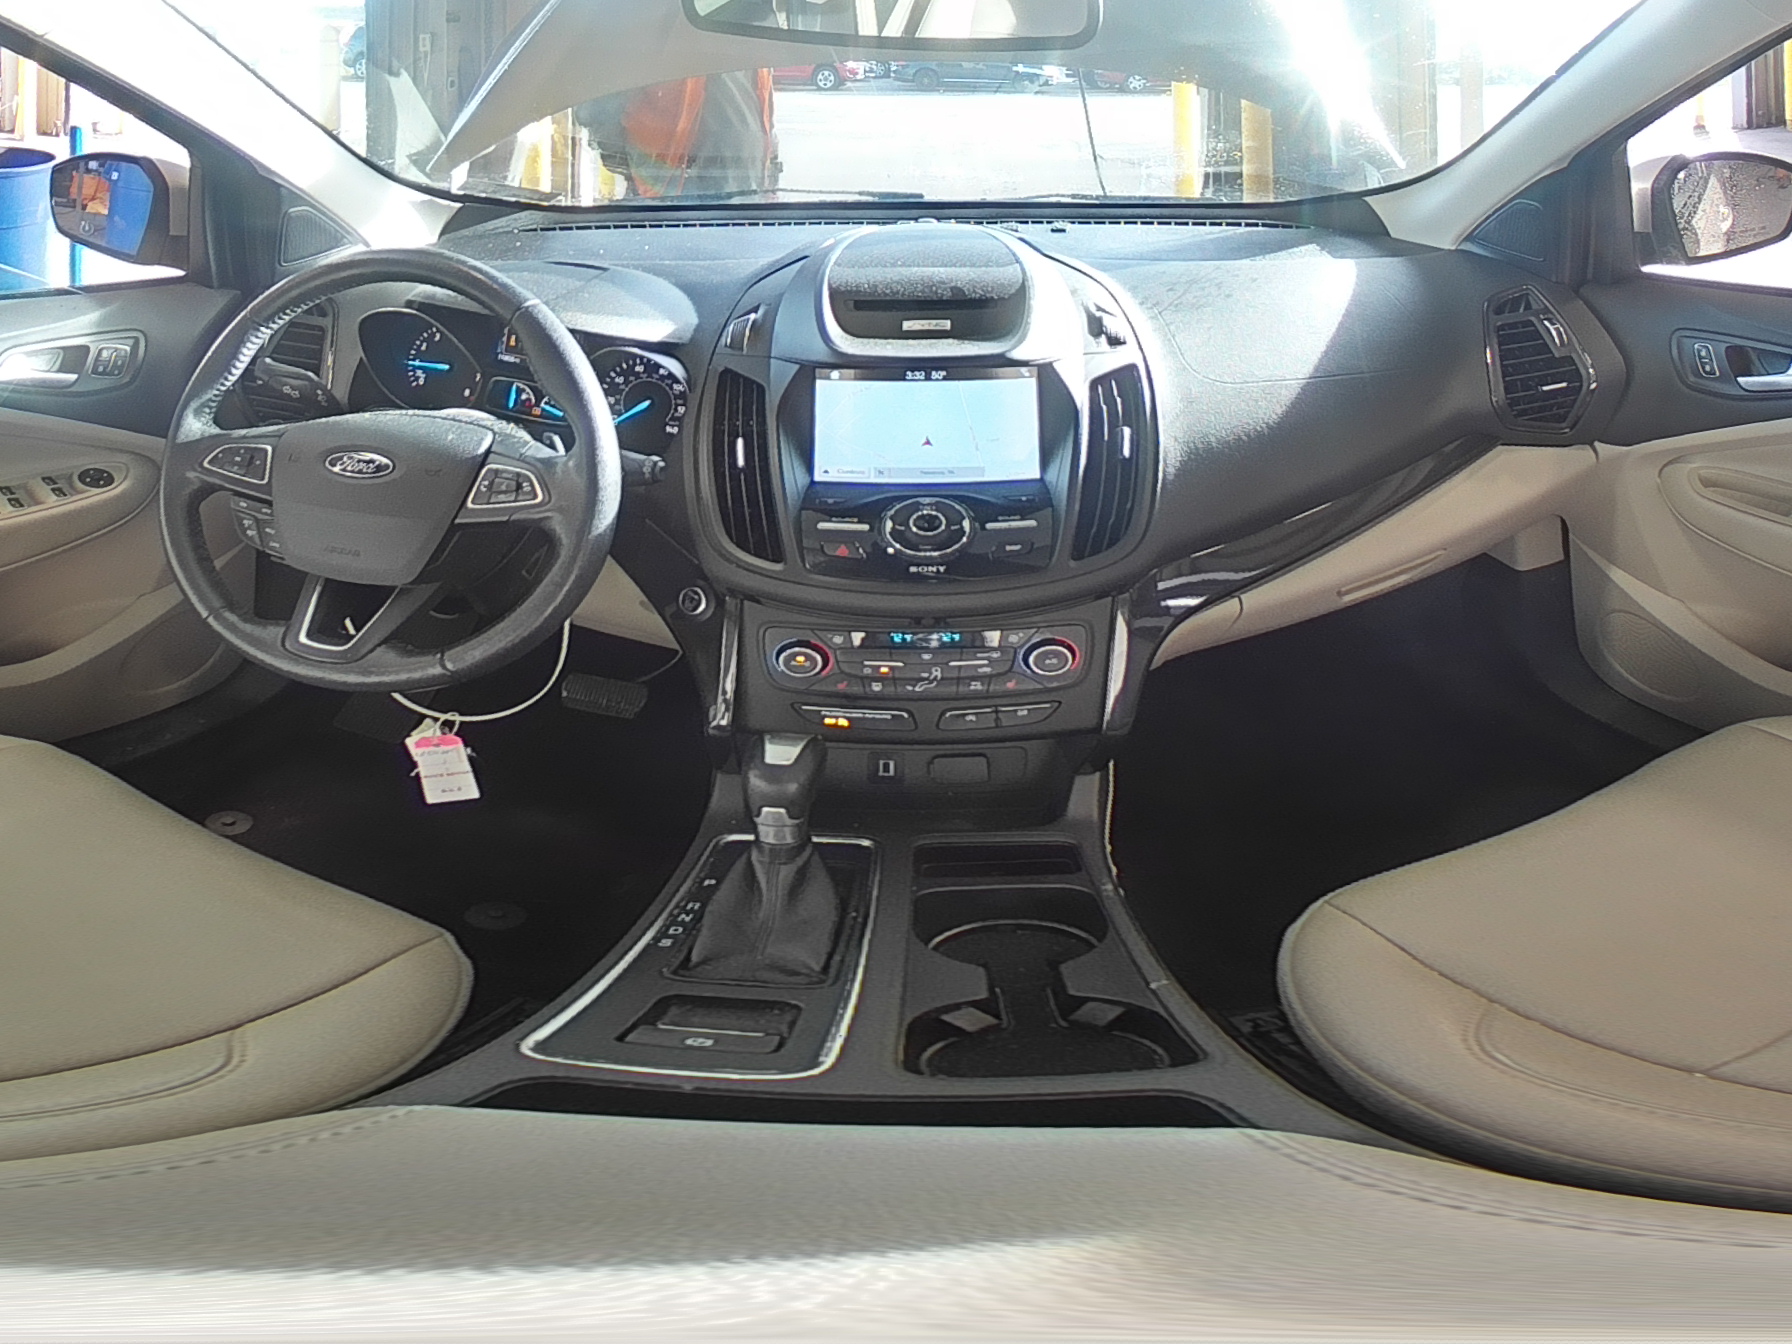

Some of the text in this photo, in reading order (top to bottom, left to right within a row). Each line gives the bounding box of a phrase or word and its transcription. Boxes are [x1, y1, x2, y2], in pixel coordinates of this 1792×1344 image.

[909, 565, 946, 574] SONY
[703, 878, 717, 887] P
[677, 913, 694, 922] N
[668, 926, 683, 935] D
[657, 938, 675, 947] S
